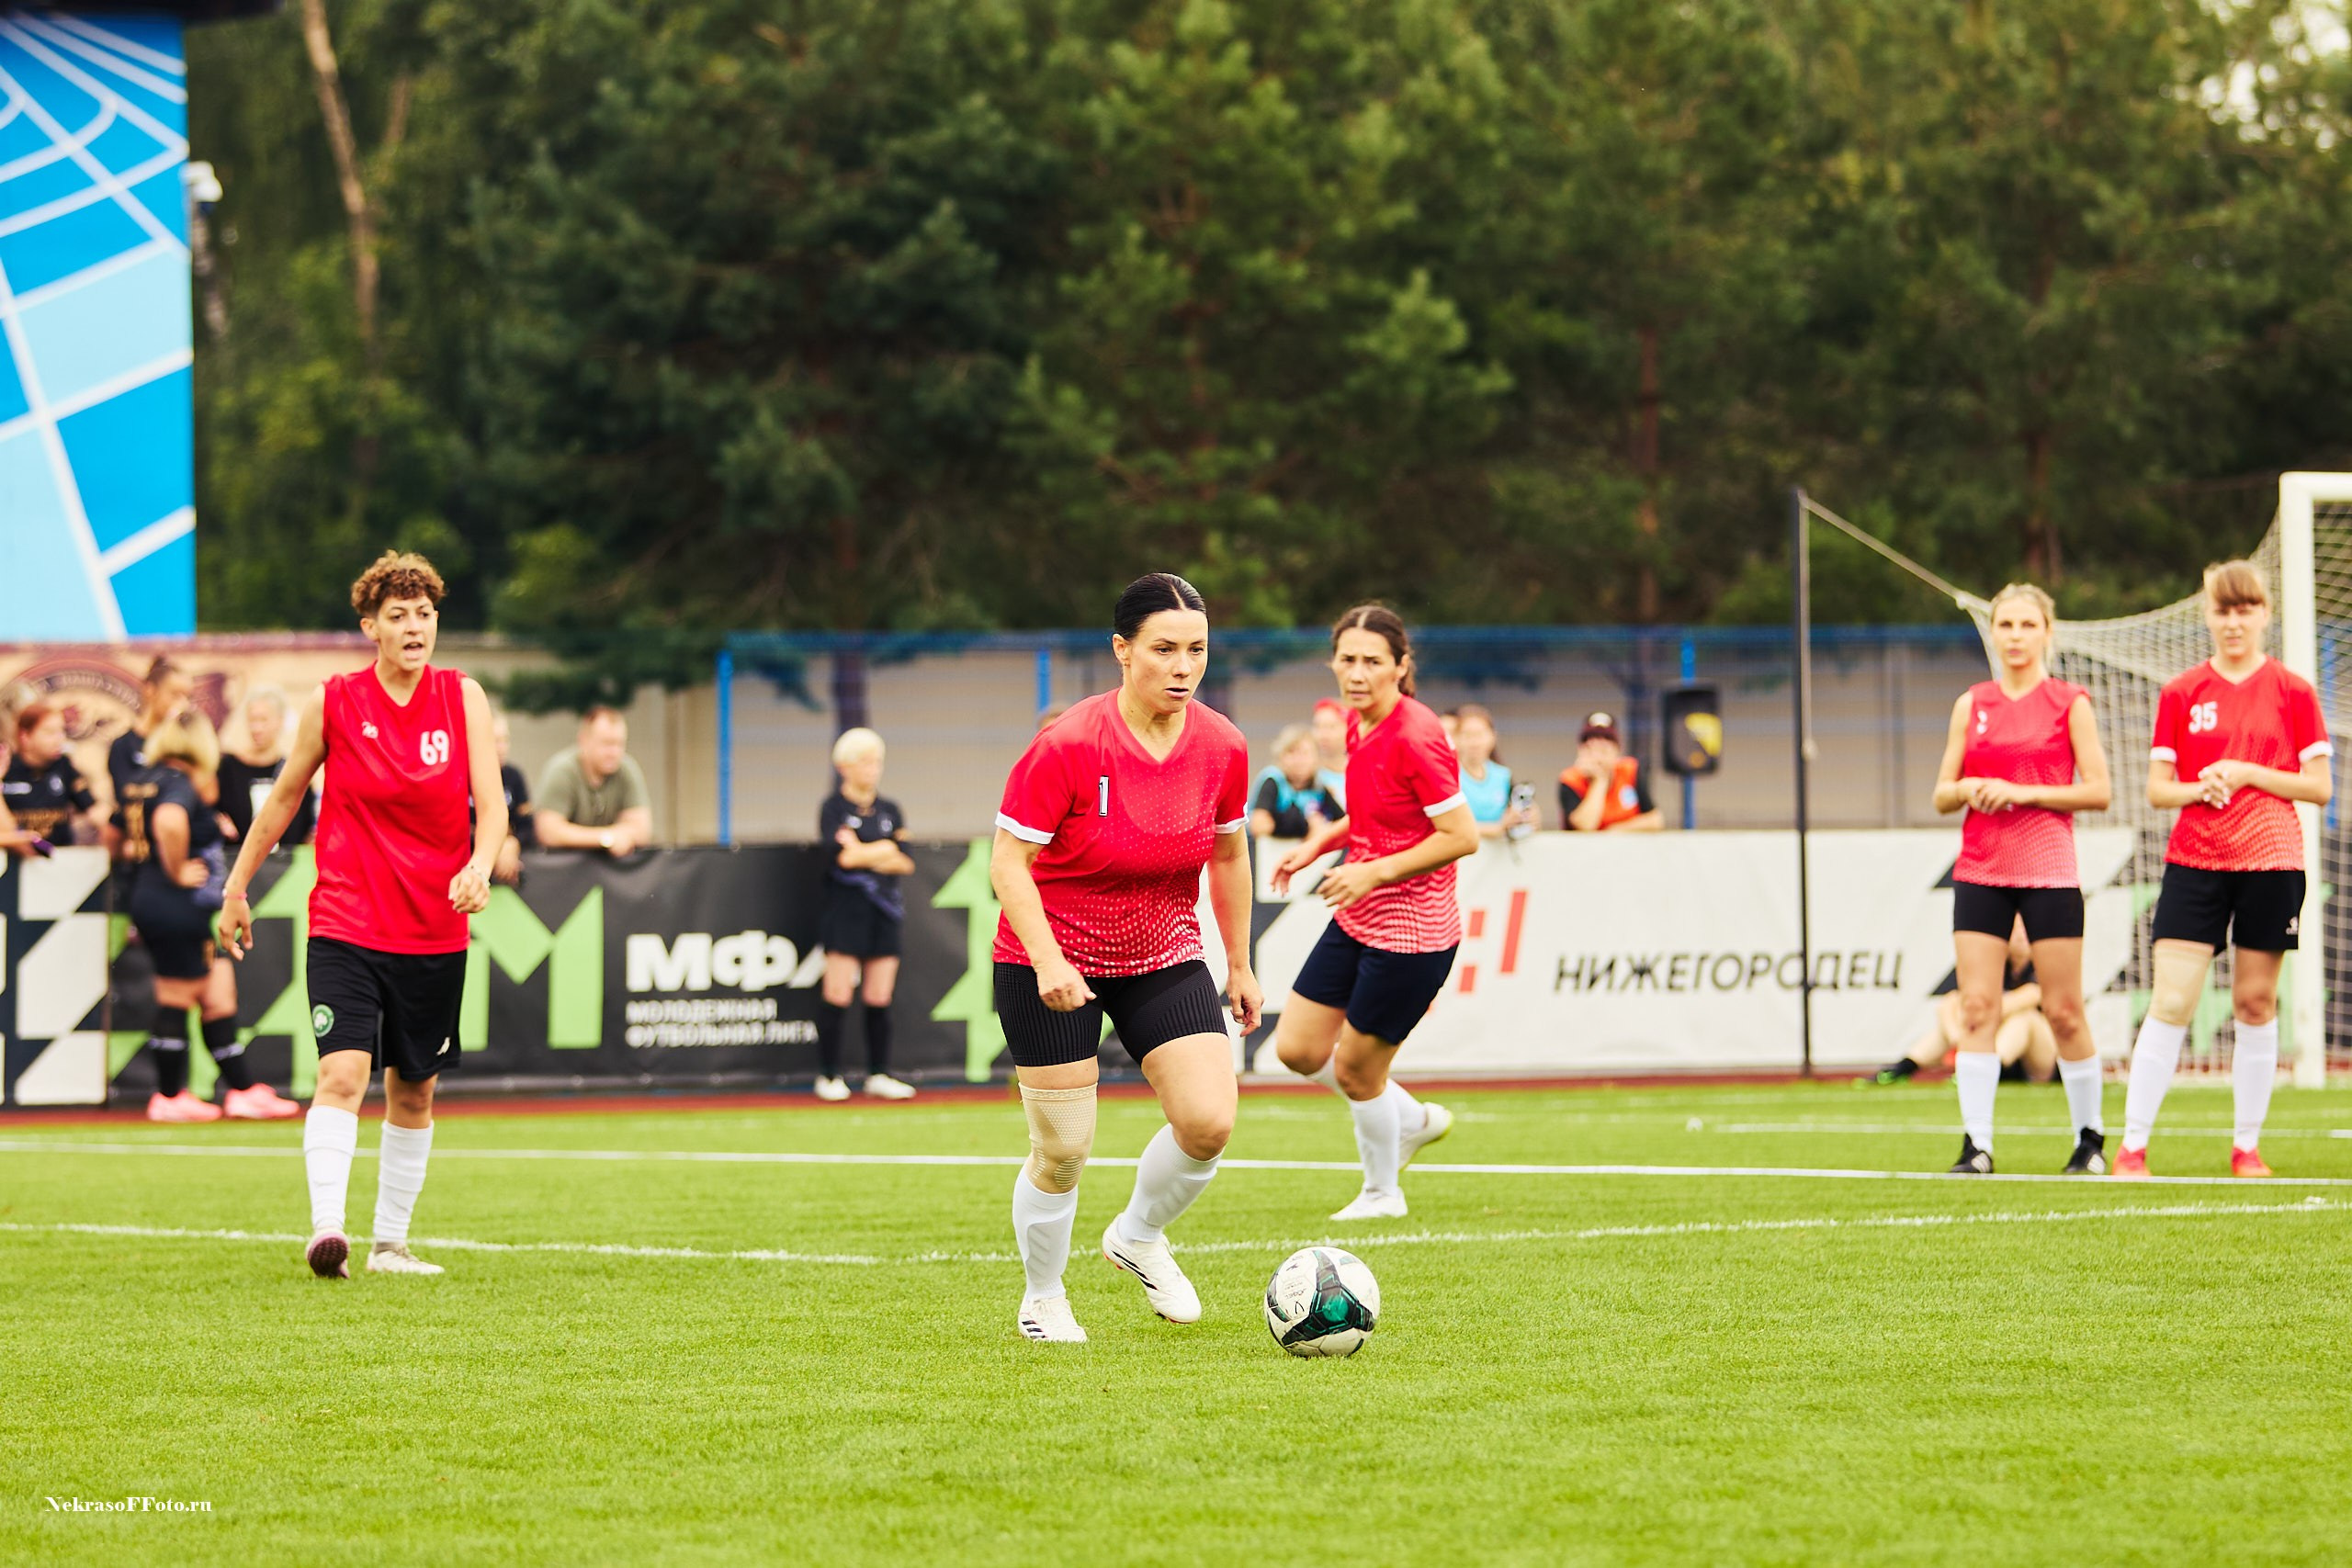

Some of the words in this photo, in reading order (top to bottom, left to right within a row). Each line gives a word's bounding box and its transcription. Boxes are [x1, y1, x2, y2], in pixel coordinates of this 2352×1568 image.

[2188, 701, 2218, 734] 35
[420, 729, 449, 765] 69
[1098, 775, 1109, 817] 1
[1553, 951, 1903, 994] НИЖЕГОРОДЕЦ
